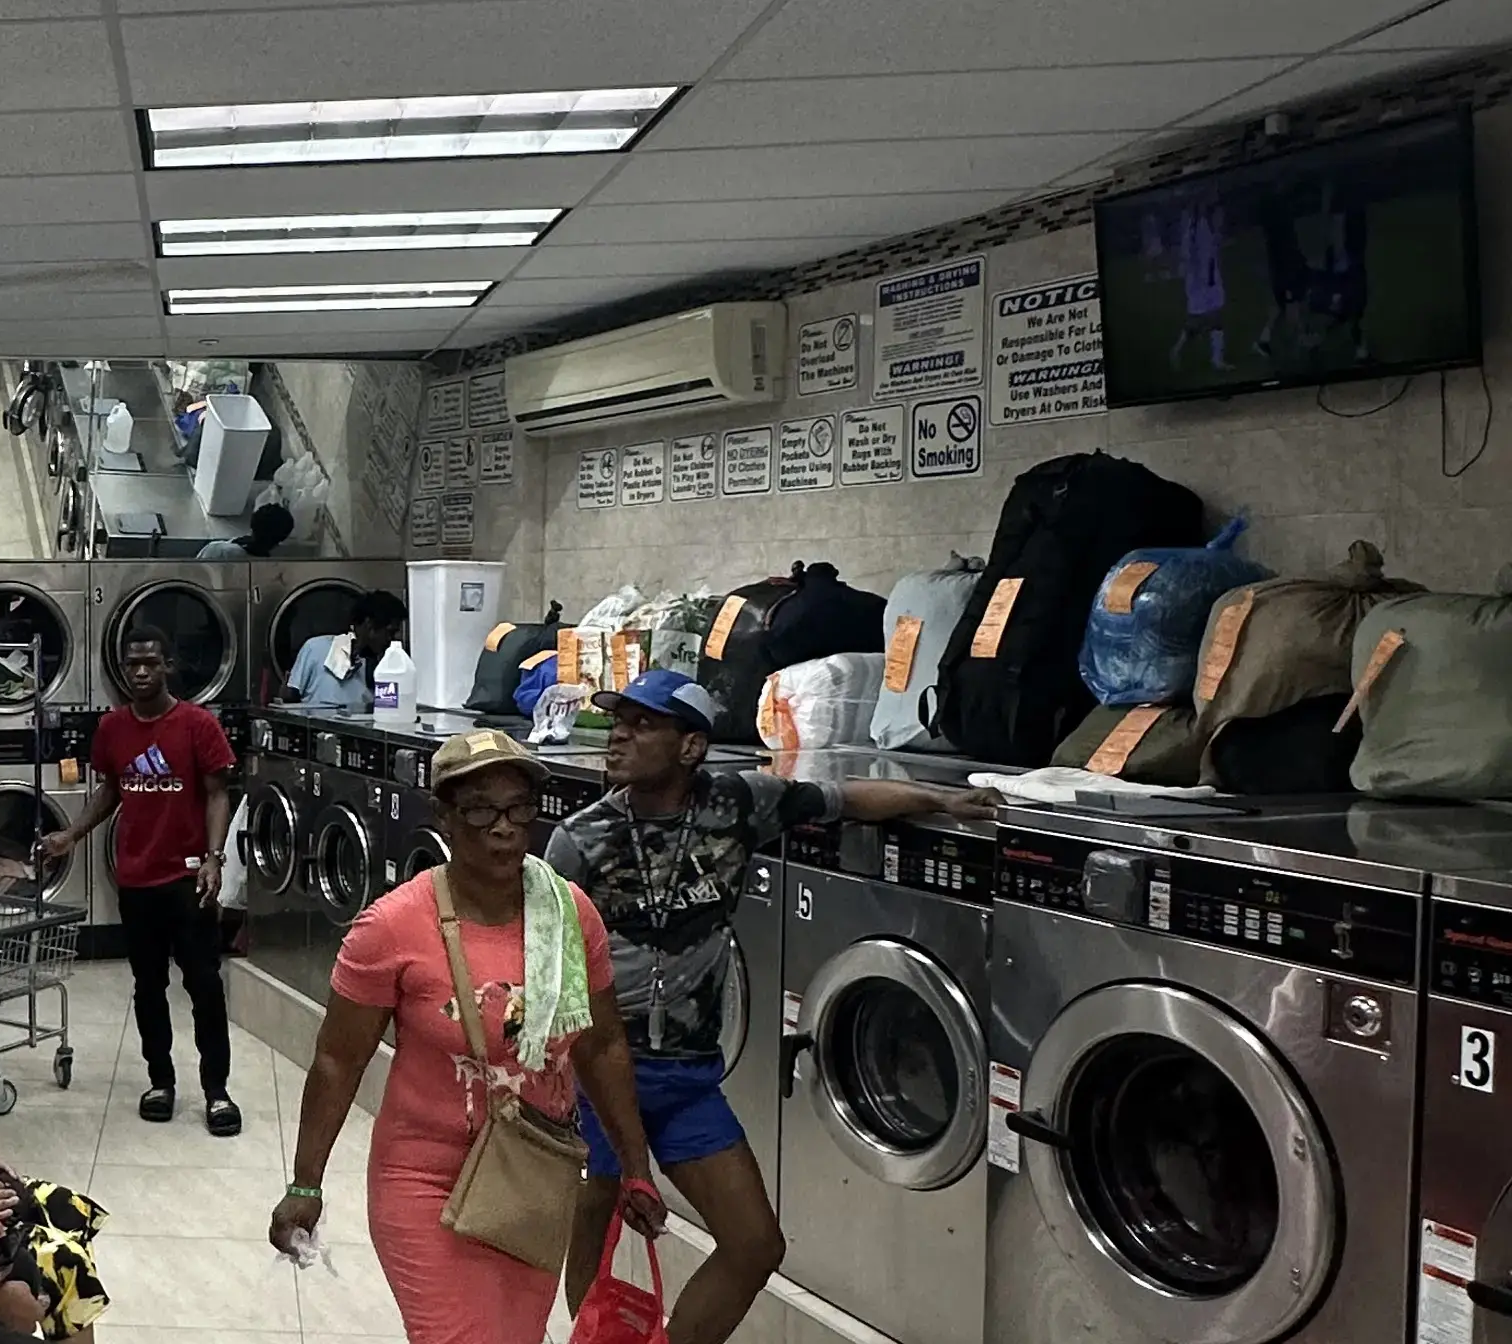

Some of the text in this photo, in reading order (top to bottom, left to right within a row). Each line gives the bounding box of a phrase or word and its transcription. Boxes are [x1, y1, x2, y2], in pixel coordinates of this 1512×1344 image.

[937, 264, 978, 282] DRYING
[891, 277, 965, 304] INSTRUCTIONS
[1001, 283, 1097, 315] NOTIC
[1027, 307, 1089, 329] We Are Not
[1001, 322, 1102, 349] Responsible For Lo
[801, 340, 827, 353] Do Not
[997, 339, 1103, 366] Or Damage To Cloth
[801, 352, 835, 367] Overload
[891, 352, 960, 376] WARNING!
[800, 364, 853, 381] The Machines
[1012, 363, 1100, 384] WARNING!
[1010, 378, 1103, 401] Use Washers And
[1003, 395, 1107, 420] Dryers At Own Risk
[859, 422, 886, 434] Do Not
[918, 419, 936, 440] No
[781, 437, 806, 449] Empty
[848, 437, 869, 447] Wash
[883, 433, 896, 444] Dry
[781, 451, 809, 461] Pockets
[852, 449, 871, 460] Rugs
[918, 443, 974, 469] Smoking
[781, 462, 832, 475] Before Using
[843, 459, 901, 472] Rubber Backing
[781, 477, 818, 488] Machines
[95, 587, 103, 604] 3
[678, 642, 697, 664] fre
[120, 773, 184, 792] adidas
[801, 883, 812, 918] 5
[1465, 1031, 1490, 1087] 3
